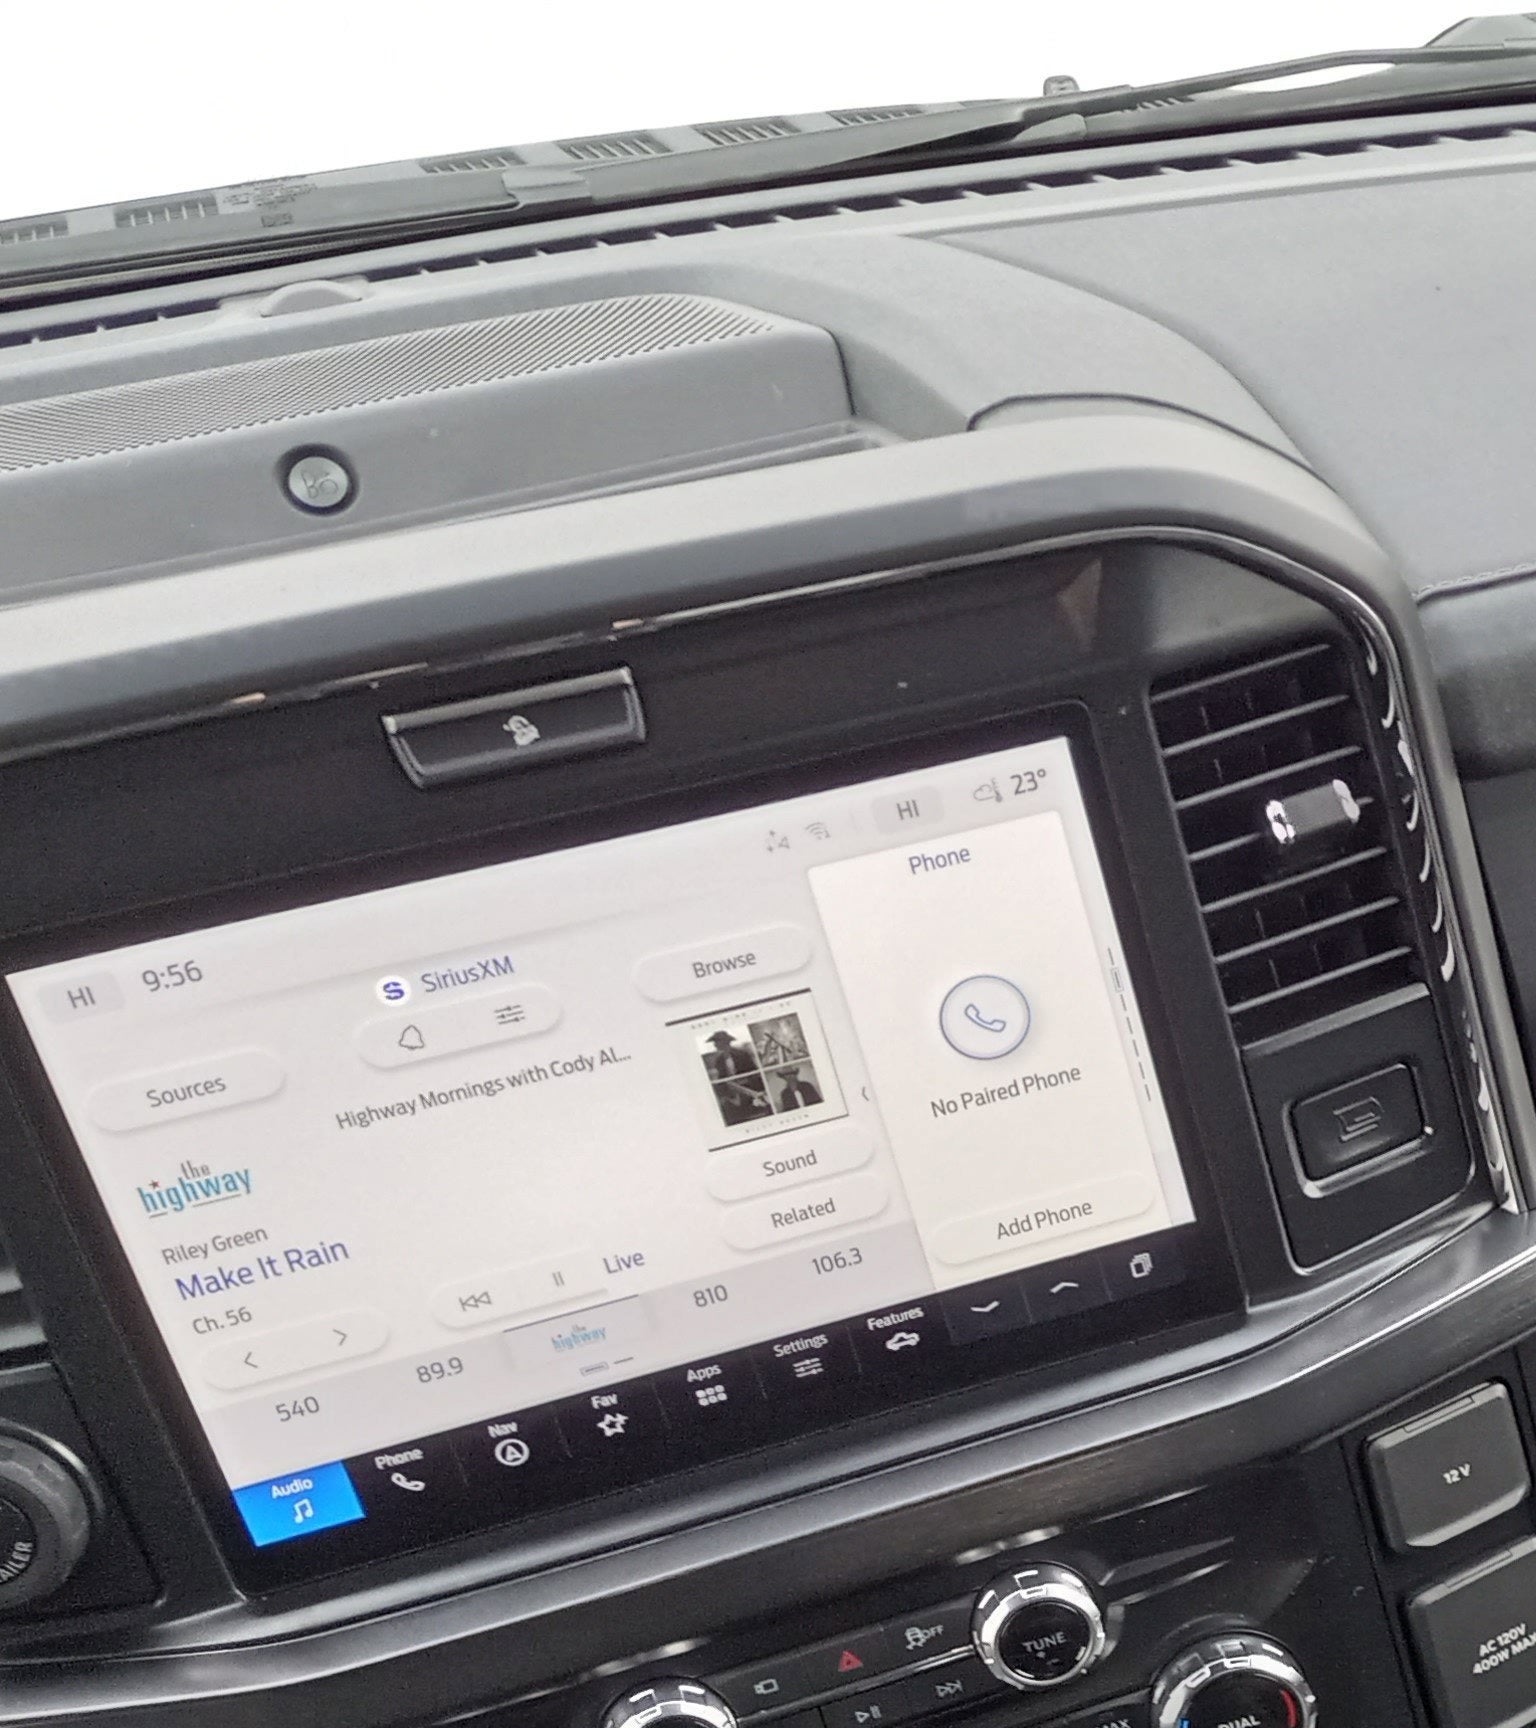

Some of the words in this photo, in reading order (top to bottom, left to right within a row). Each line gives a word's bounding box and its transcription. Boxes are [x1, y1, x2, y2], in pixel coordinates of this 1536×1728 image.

[908, 844, 972, 875] Phone
[141, 959, 203, 993] 9:56
[421, 955, 515, 993] SiriusXM
[691, 948, 757, 980] Browse
[66, 987, 96, 1009] HI
[146, 1077, 226, 1108] Sources
[335, 1098, 417, 1130] Highway
[419, 1076, 505, 1110] Mornings
[507, 1065, 549, 1089] with
[549, 1054, 595, 1078] Cody
[930, 1094, 959, 1119] No
[962, 1078, 1021, 1112] Paired
[1023, 1063, 1082, 1097] Phone
[180, 1160, 211, 1180] the
[762, 1148, 818, 1178] Sound
[137, 1168, 251, 1213] highway
[770, 1197, 837, 1229] Related
[994, 1215, 1032, 1241] Add
[1034, 1199, 1093, 1230] Phone
[162, 1237, 209, 1267] Riley
[211, 1225, 268, 1254] Green
[174, 1262, 256, 1303] Make
[262, 1255, 284, 1281] It
[287, 1238, 350, 1274] Rain
[602, 1248, 646, 1277] Live
[810, 1247, 864, 1275] 106.3
[692, 1283, 730, 1309] 810
[192, 1312, 225, 1337] Ch.
[225, 1305, 253, 1328] 56
[866, 1304, 924, 1330] Features
[772, 1331, 829, 1359] Settings
[416, 1355, 464, 1385] 89.9
[686, 1361, 722, 1384] Apps
[275, 1395, 320, 1424] 540
[591, 1393, 618, 1410] Fav
[488, 1419, 518, 1437] Nav
[374, 1446, 425, 1472] Phone
[270, 1476, 314, 1499] Audio
[923, 1624, 944, 1640] OFF
[1022, 1631, 1067, 1653] TUNE
[1479, 1640, 1497, 1657] AC
[1496, 1622, 1526, 1646] 120V
[1473, 1648, 1509, 1673] 400W
